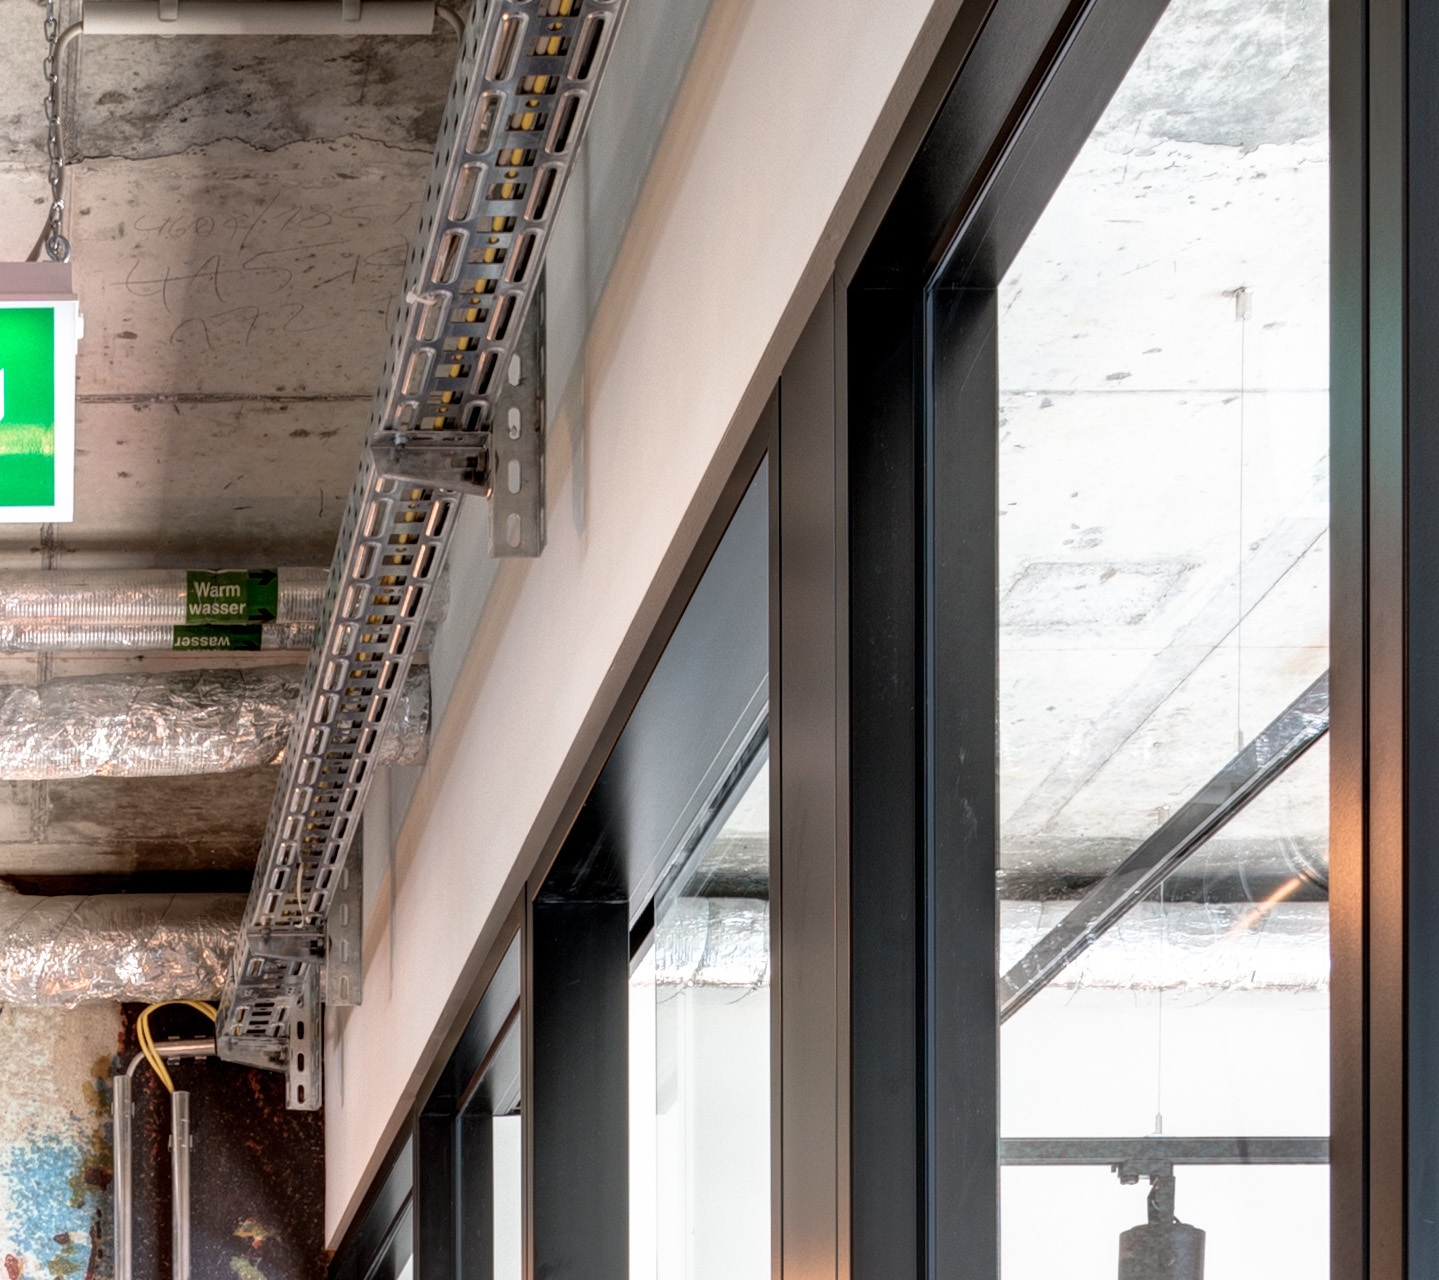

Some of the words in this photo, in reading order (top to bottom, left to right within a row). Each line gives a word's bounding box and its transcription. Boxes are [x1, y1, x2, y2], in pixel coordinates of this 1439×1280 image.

[193, 581, 240, 597] Warm
[188, 602, 247, 615] wasser
[174, 636, 231, 647] wasser
